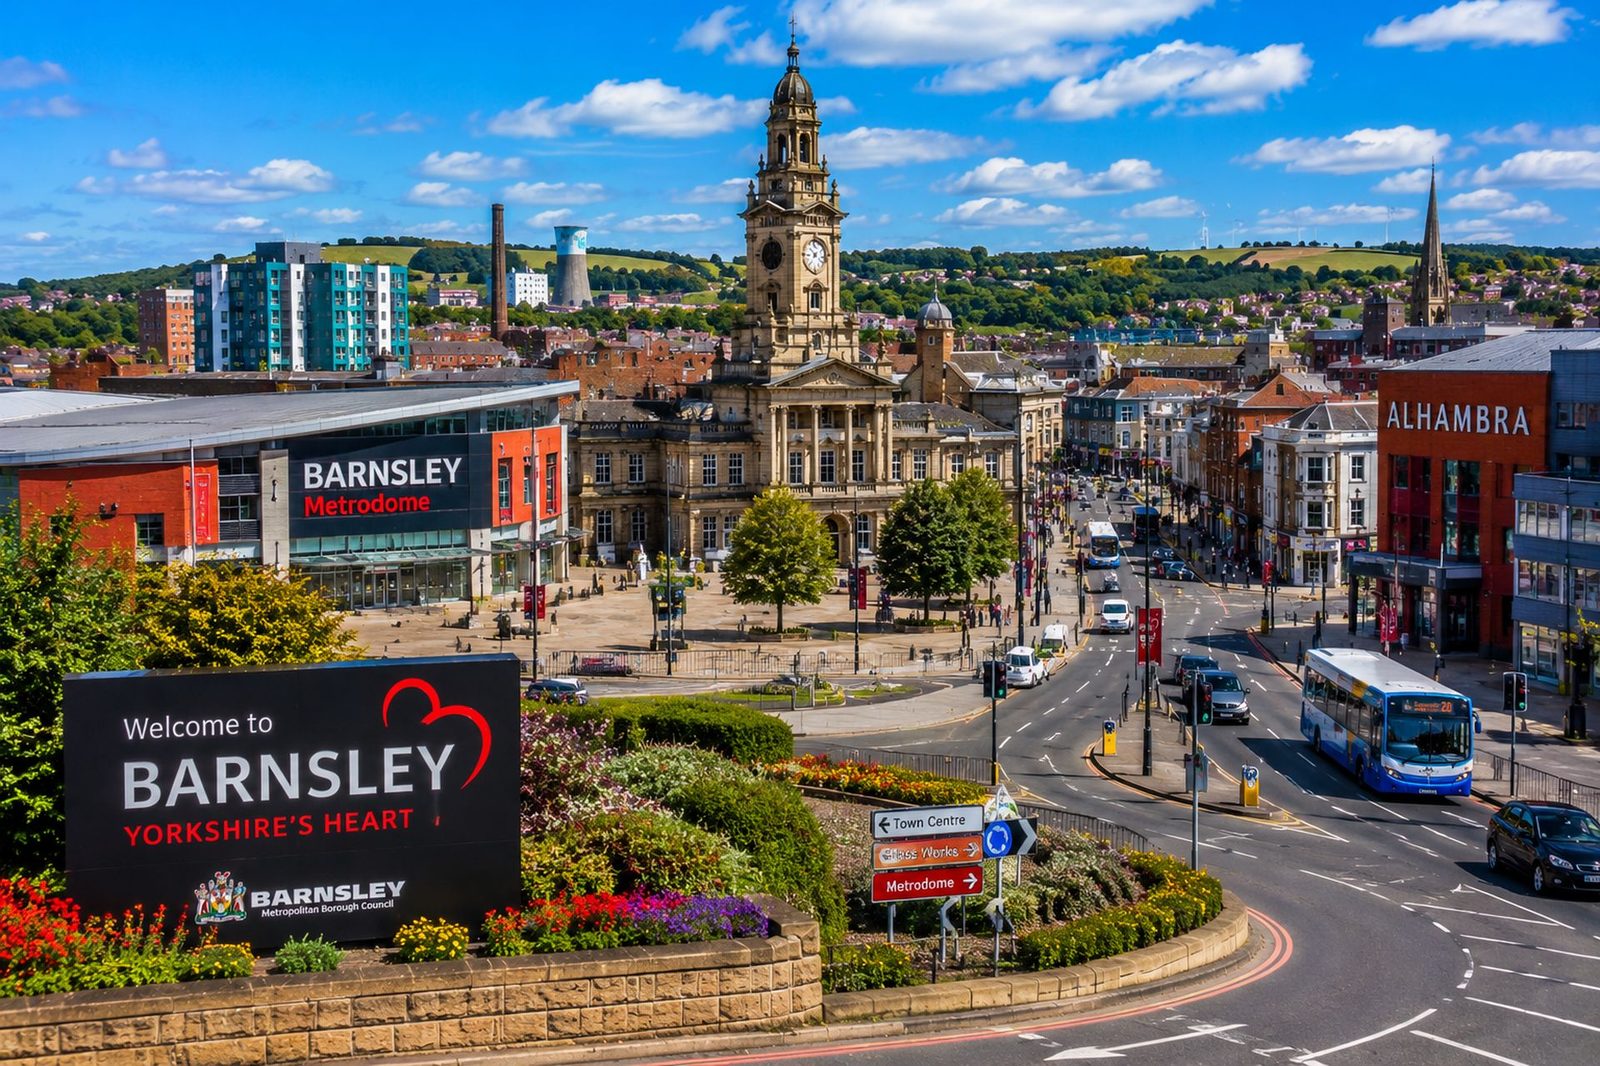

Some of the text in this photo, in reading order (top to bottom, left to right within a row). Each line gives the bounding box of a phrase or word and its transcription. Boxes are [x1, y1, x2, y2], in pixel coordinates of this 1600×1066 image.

[1387, 401, 1531, 436] ALHAMBRA
[303, 457, 463, 490] BARNSLEY
[304, 493, 430, 517] Metrodome
[1440, 701, 1453, 713] 20
[123, 713, 273, 741] Welcome to
[123, 743, 455, 811] BARNSLEY
[124, 808, 414, 847] YORKSHIRE'S HEART
[894, 815, 966, 829] Town Centre
[922, 845, 959, 859] Works
[250, 880, 406, 908] BARNSLEY
[886, 877, 955, 893] Metrodome
[261, 899, 394, 918] Metropolitan Borough Council
